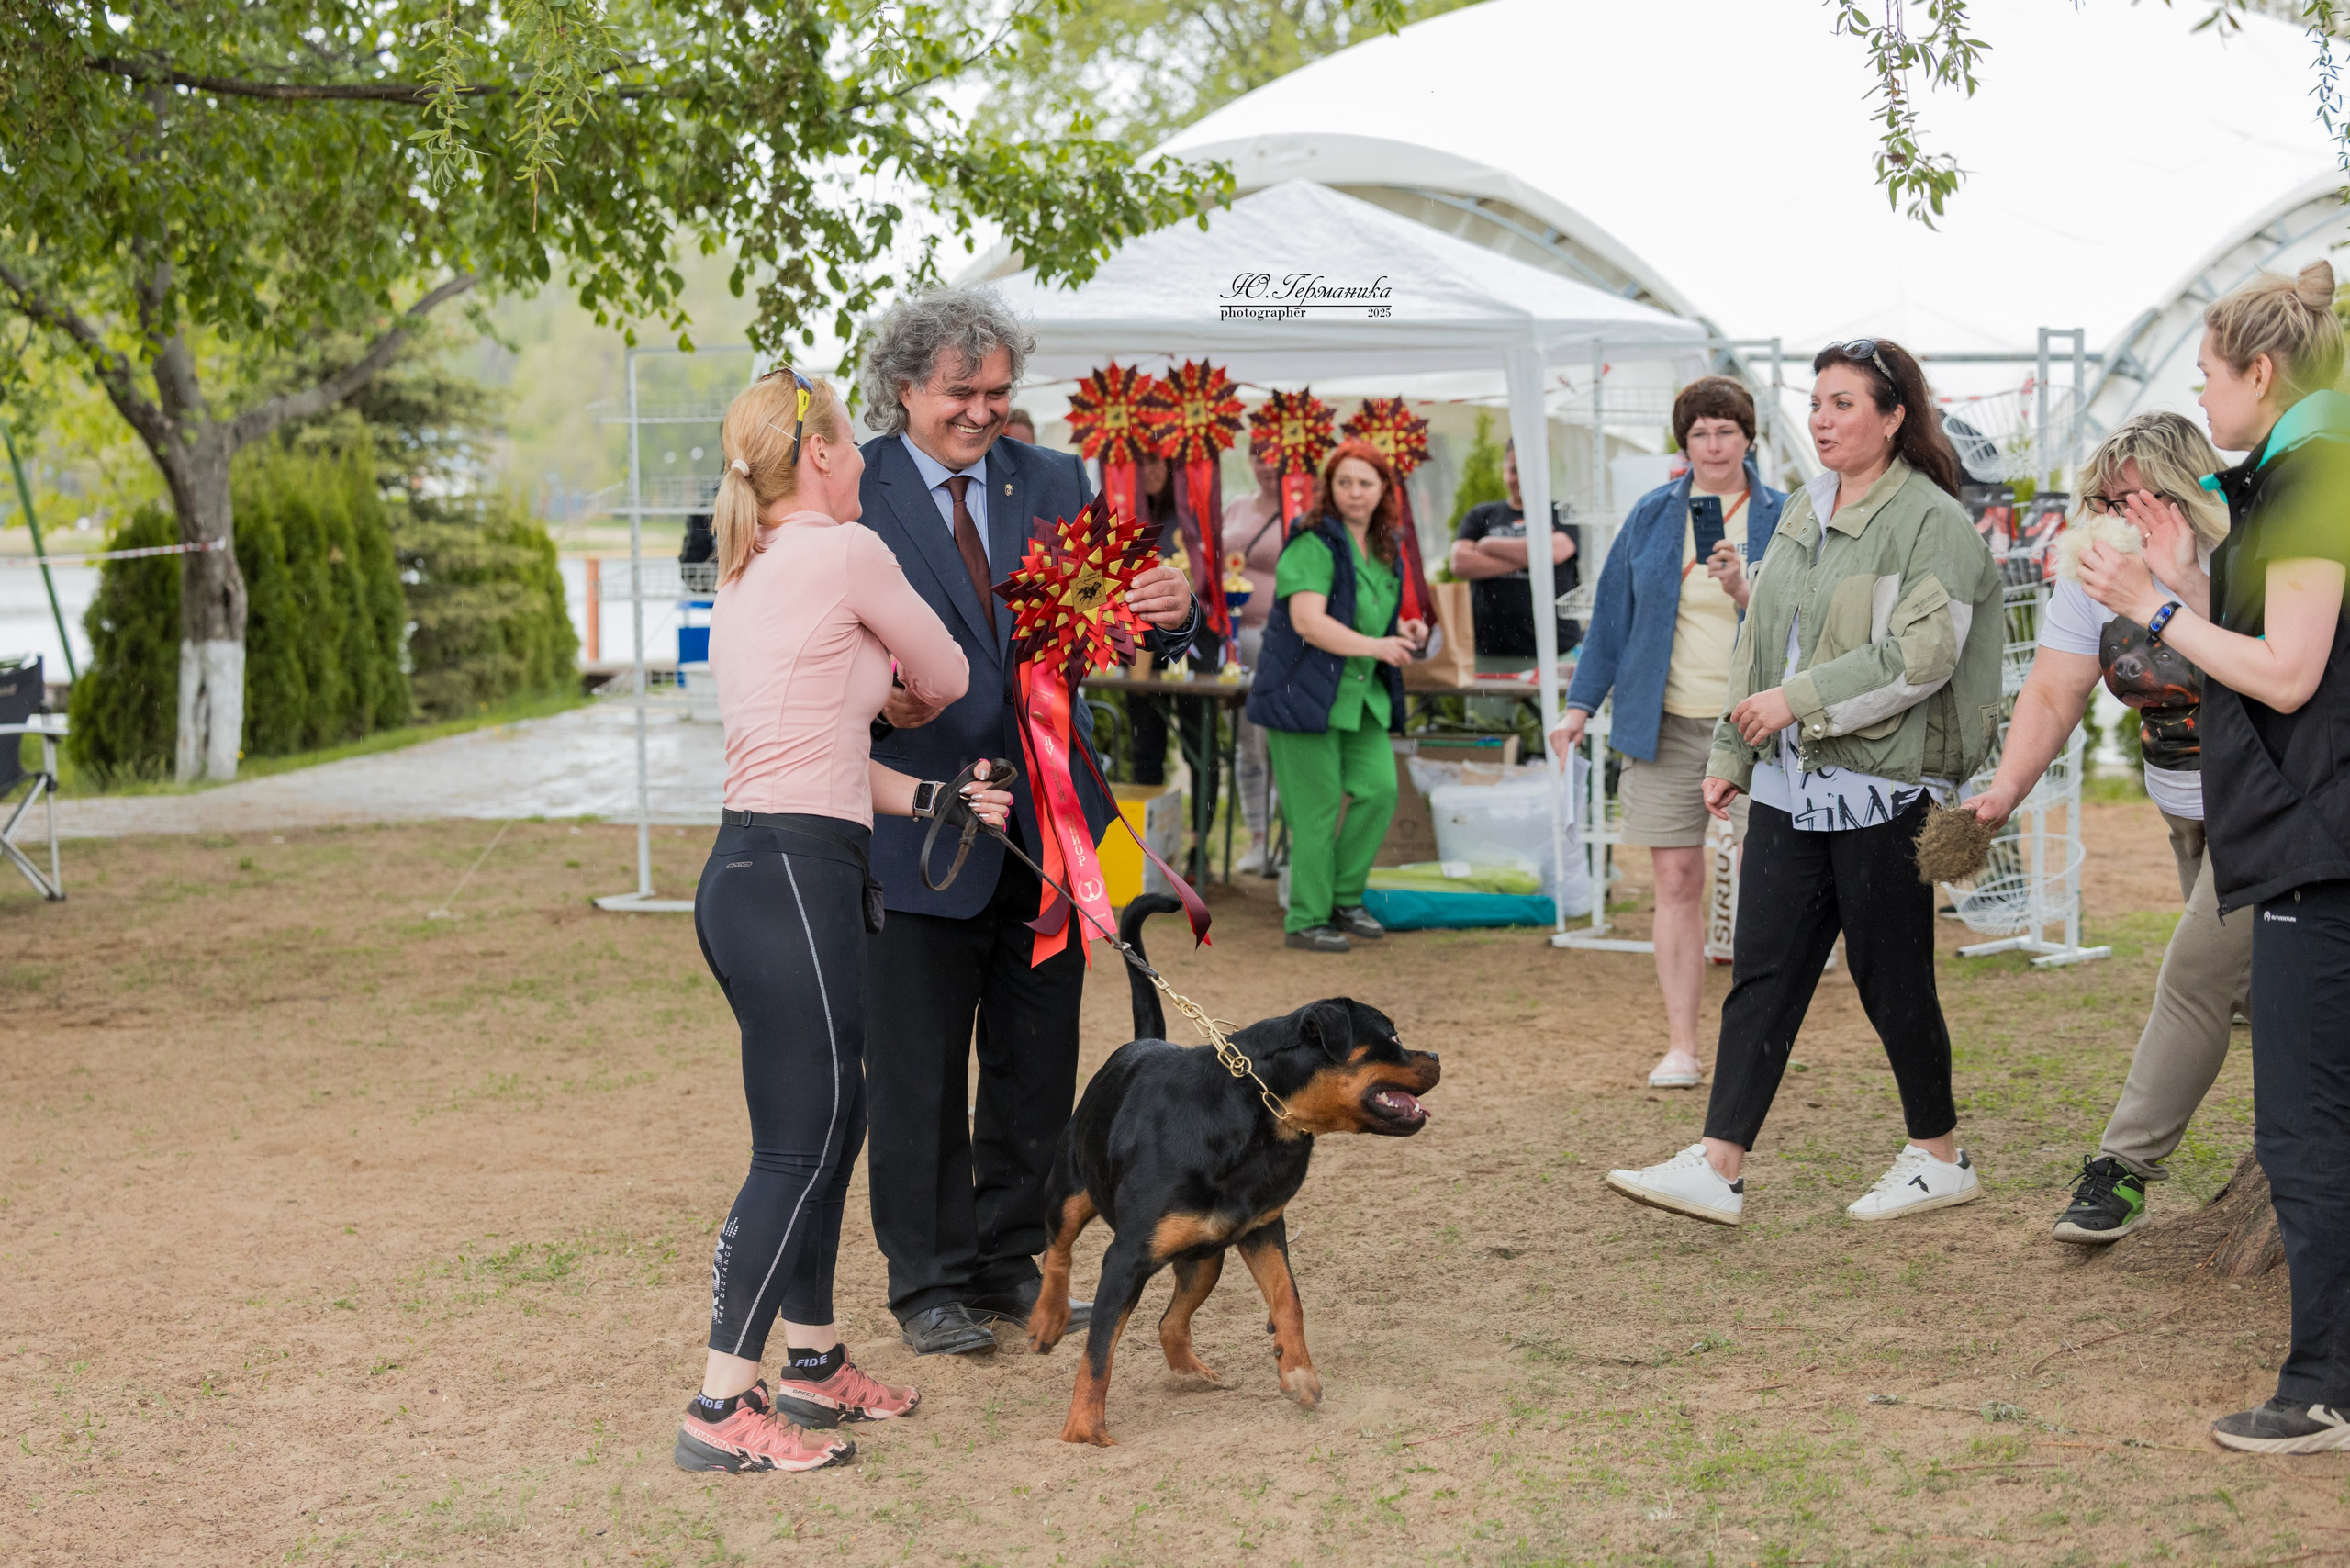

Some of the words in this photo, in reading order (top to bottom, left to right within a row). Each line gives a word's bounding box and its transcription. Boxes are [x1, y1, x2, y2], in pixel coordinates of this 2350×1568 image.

[1065, 812, 1086, 867] ЮНИОР
[720, 1244, 733, 1299] DISTANCE
[795, 1354, 828, 1367] FIDE
[792, 1388, 816, 1398] SPEED
[698, 1394, 725, 1410] FIDE
